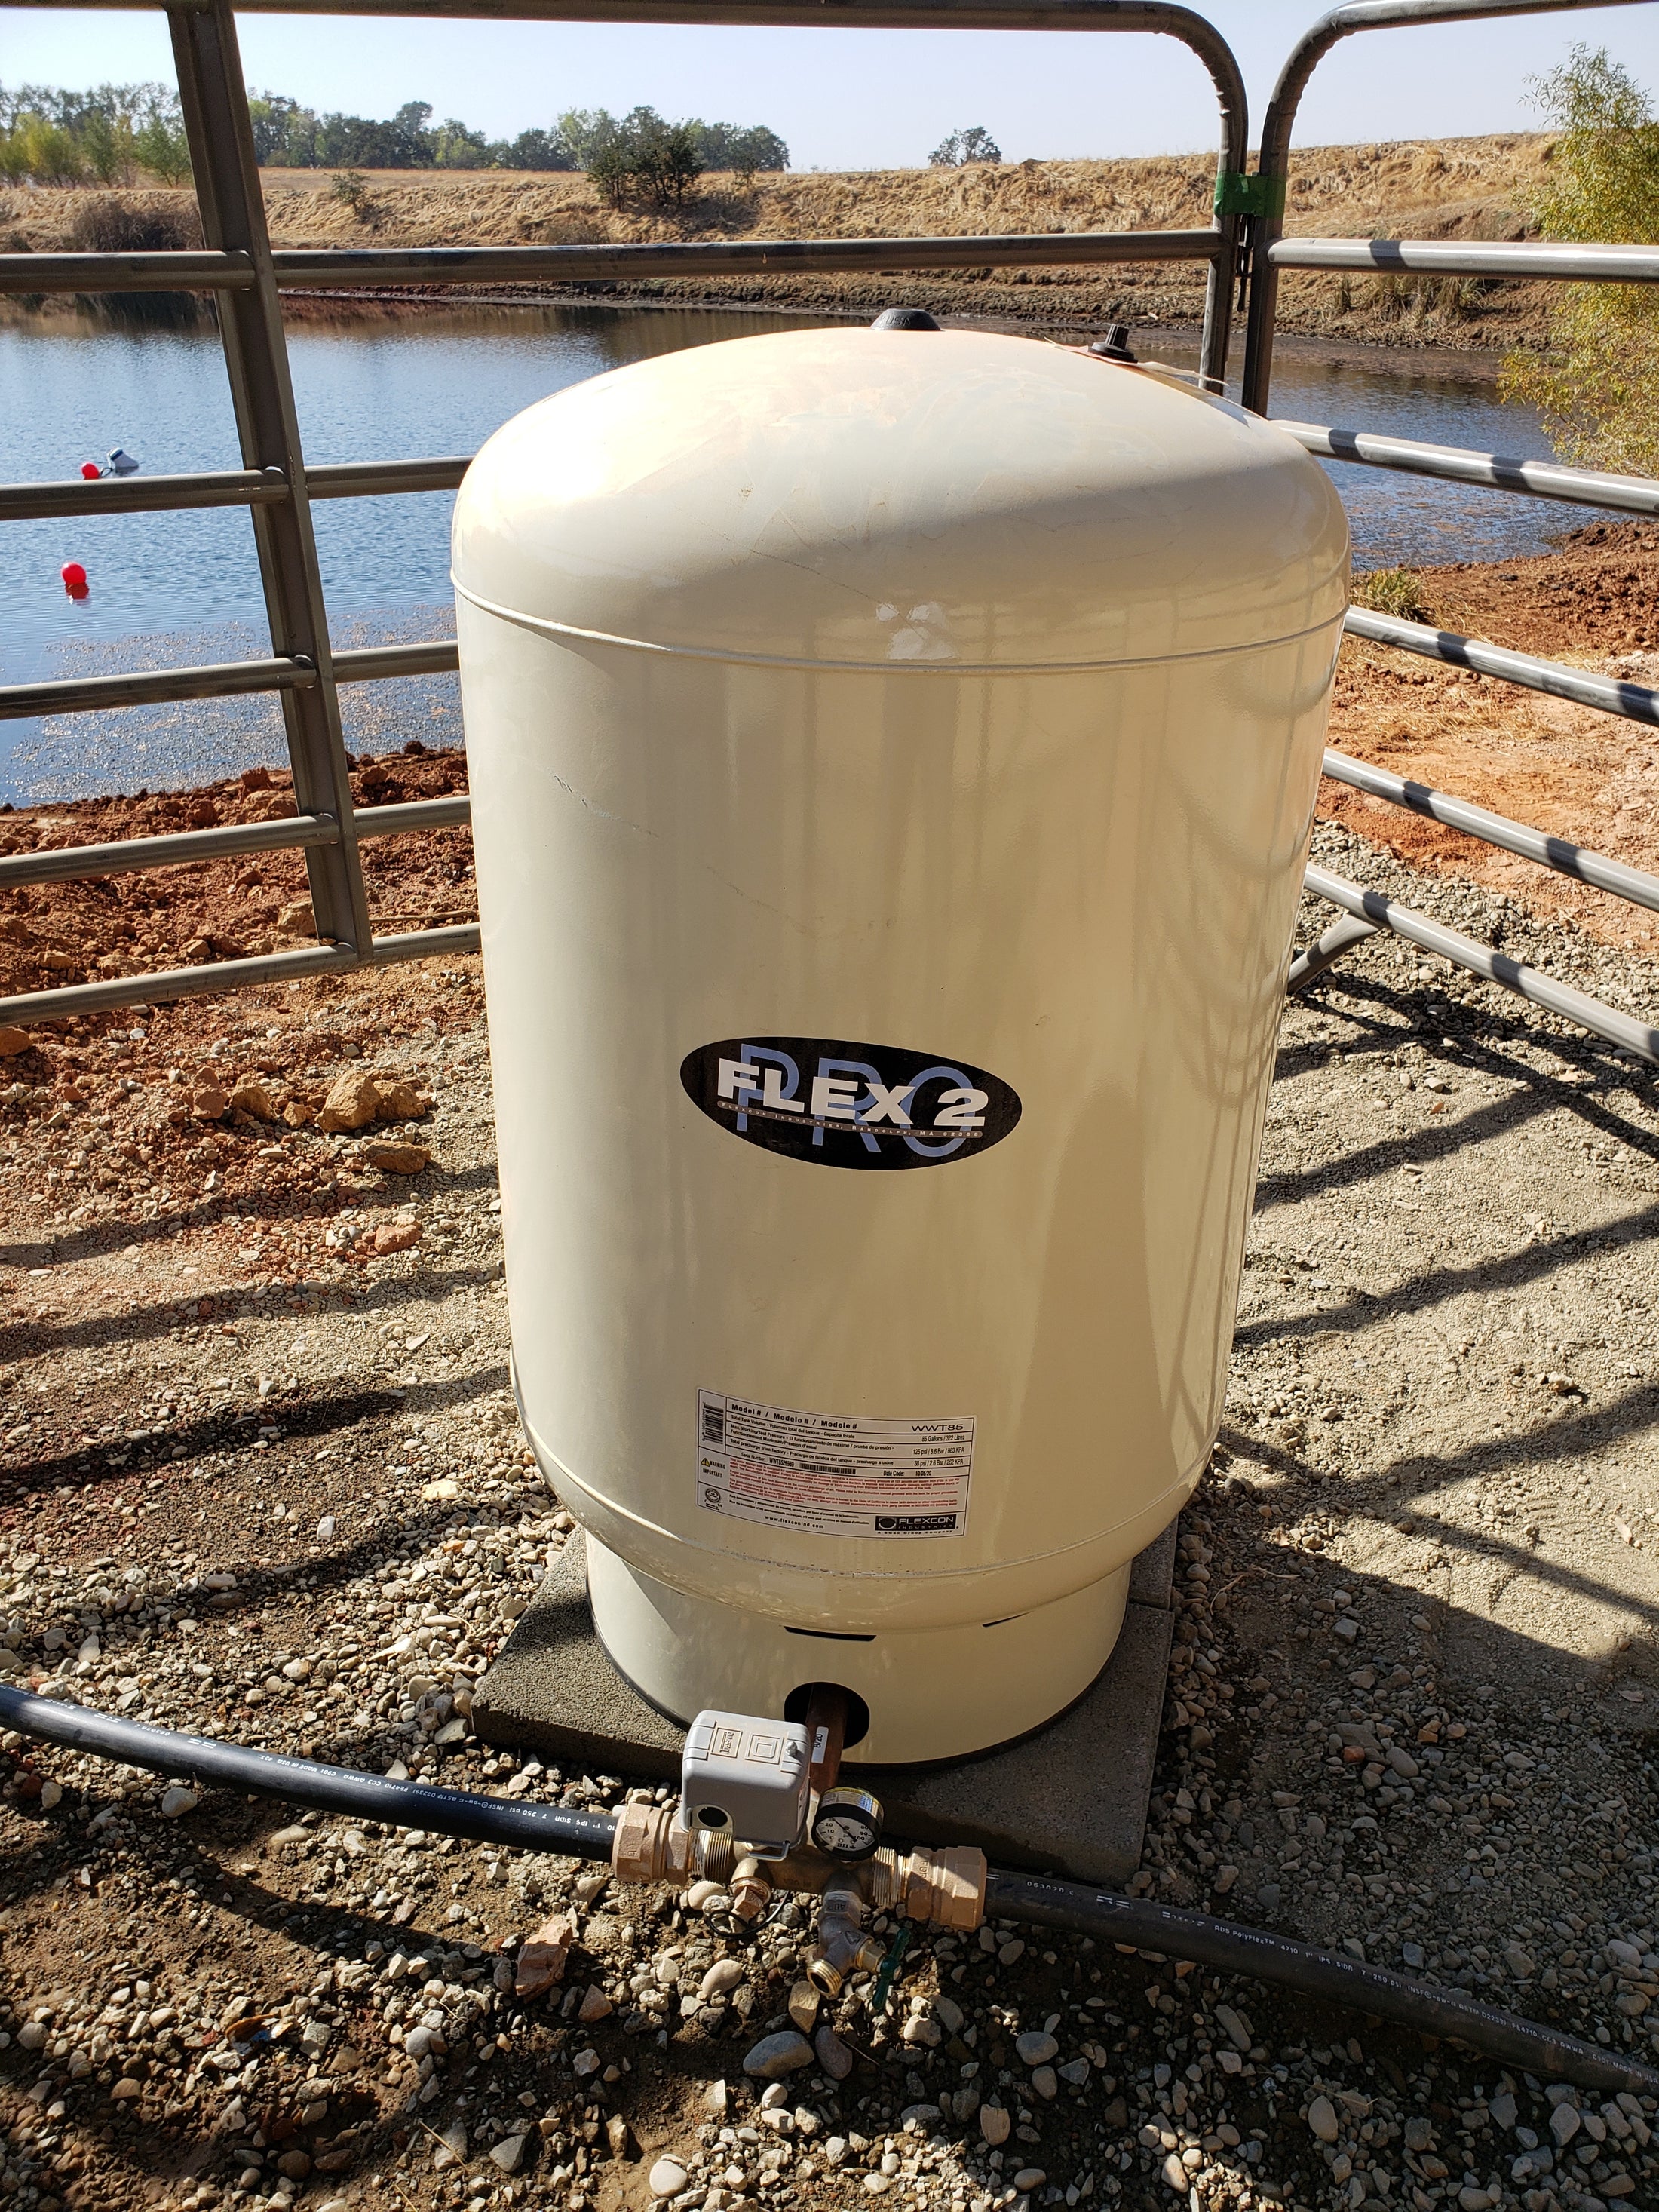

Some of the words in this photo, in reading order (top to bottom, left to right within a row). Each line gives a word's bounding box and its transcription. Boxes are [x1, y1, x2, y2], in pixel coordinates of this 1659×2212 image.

[717, 1057, 917, 1126] FLEX
[933, 1088, 989, 1127] 2
[731, 1404, 755, 1415] Model
[773, 1413, 802, 1423] Modelo
[911, 1423, 964, 1432] WWT85
[709, 1460, 725, 1469] WARNING
[702, 1468, 722, 1478] IMPORTANT
[765, 1515, 824, 1529] www.flexconind.com
[898, 1516, 954, 1524] FLEXCON
[814, 1734, 823, 1749] 8/20
[299, 1763, 318, 1772] MADE
[320, 1768, 337, 1777] C901
[343, 1774, 366, 1783] AWWA
[385, 1782, 409, 1792] PE4710
[522, 1809, 537, 1818] 250
[554, 1815, 572, 1824] SIDR
[1214, 1925, 1231, 1934] ADS
[1280, 1944, 1299, 1955] 4710
[1372, 1973, 1388, 1983] 250
[1458, 2003, 1480, 2014] ASTM
[1559, 2041, 1584, 2055] AWWA
[1612, 2061, 1633, 2074] MADE
[1635, 2069, 1642, 2078] IN
[1644, 2072, 1659, 2085] USA
